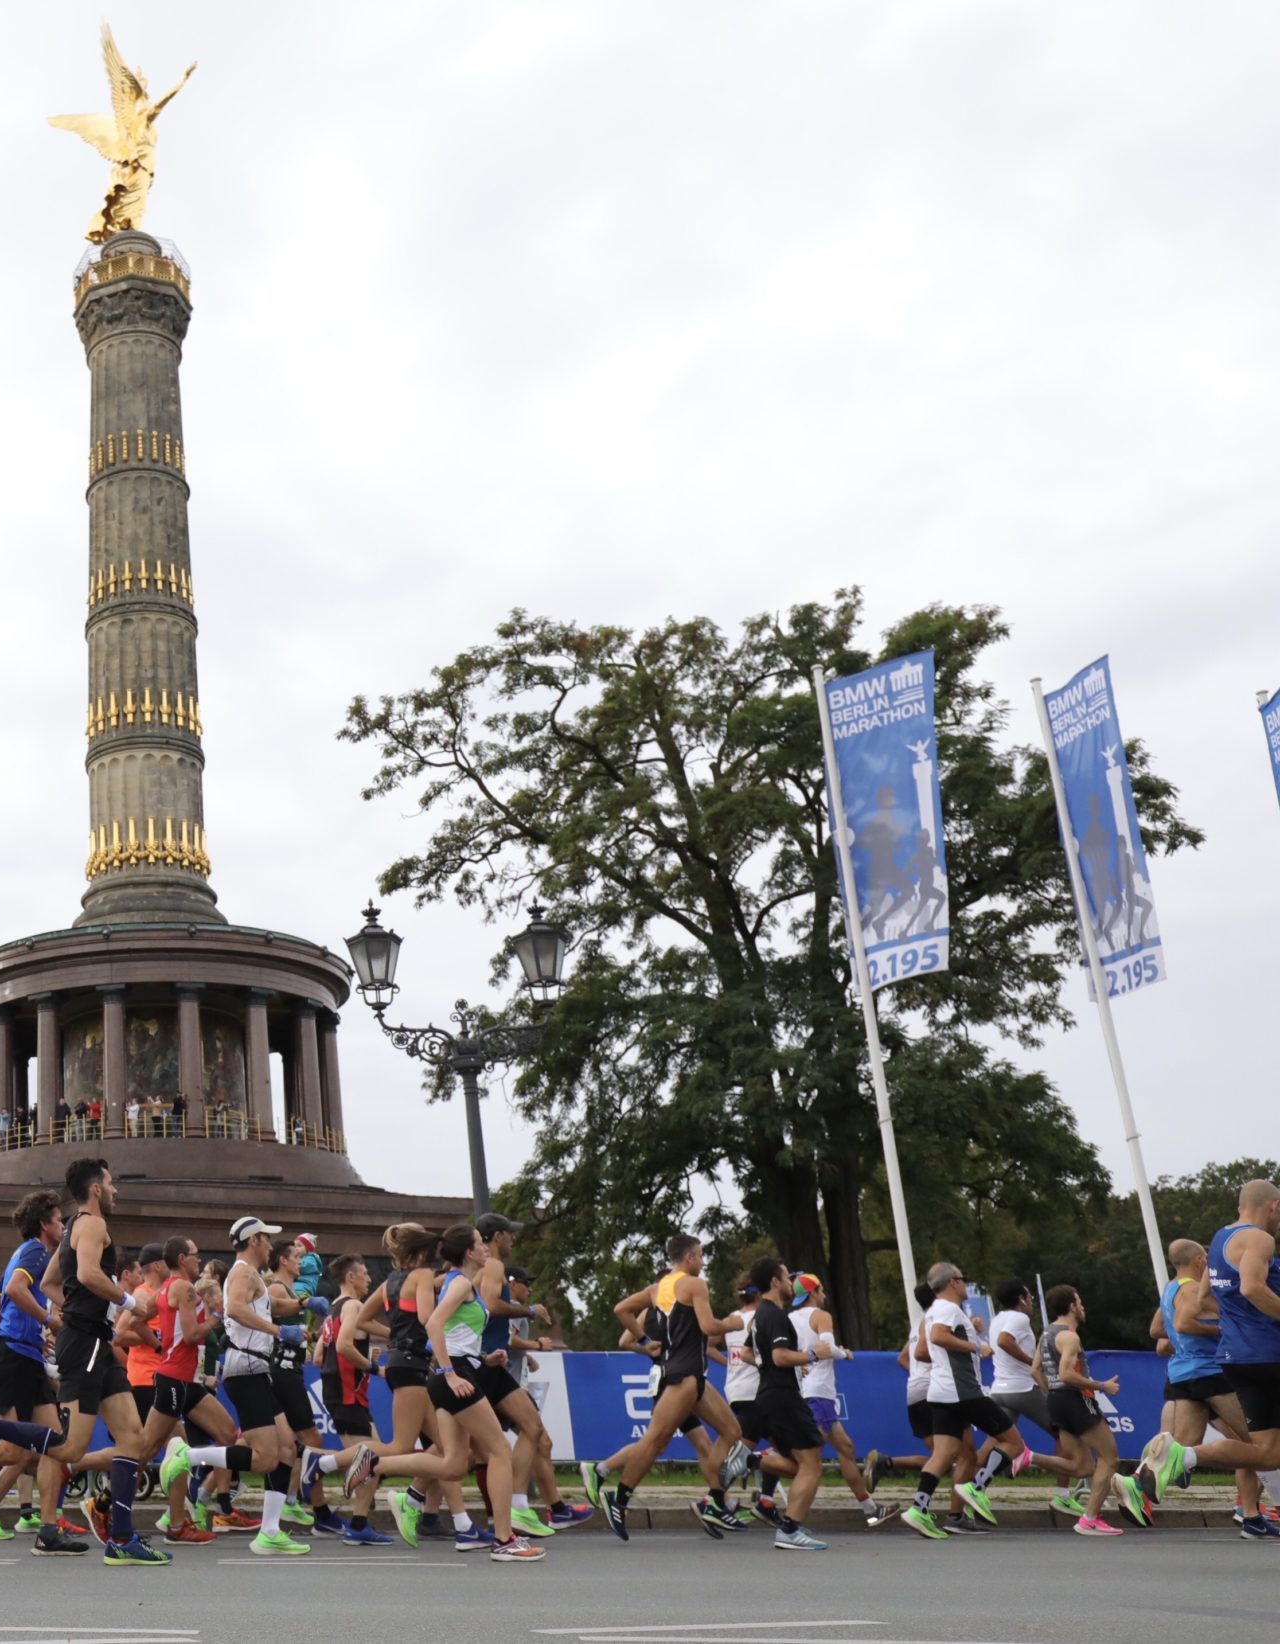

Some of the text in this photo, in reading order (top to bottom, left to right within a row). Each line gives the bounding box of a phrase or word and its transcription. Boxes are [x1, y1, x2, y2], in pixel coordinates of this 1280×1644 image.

[829, 675, 886, 709] BMW
[831, 695, 890, 725] BERLIN
[1047, 681, 1083, 720] BMW
[833, 700, 926, 740] MARATHON
[868, 943, 940, 986] 2.195
[1105, 954, 1159, 997] 2.195
